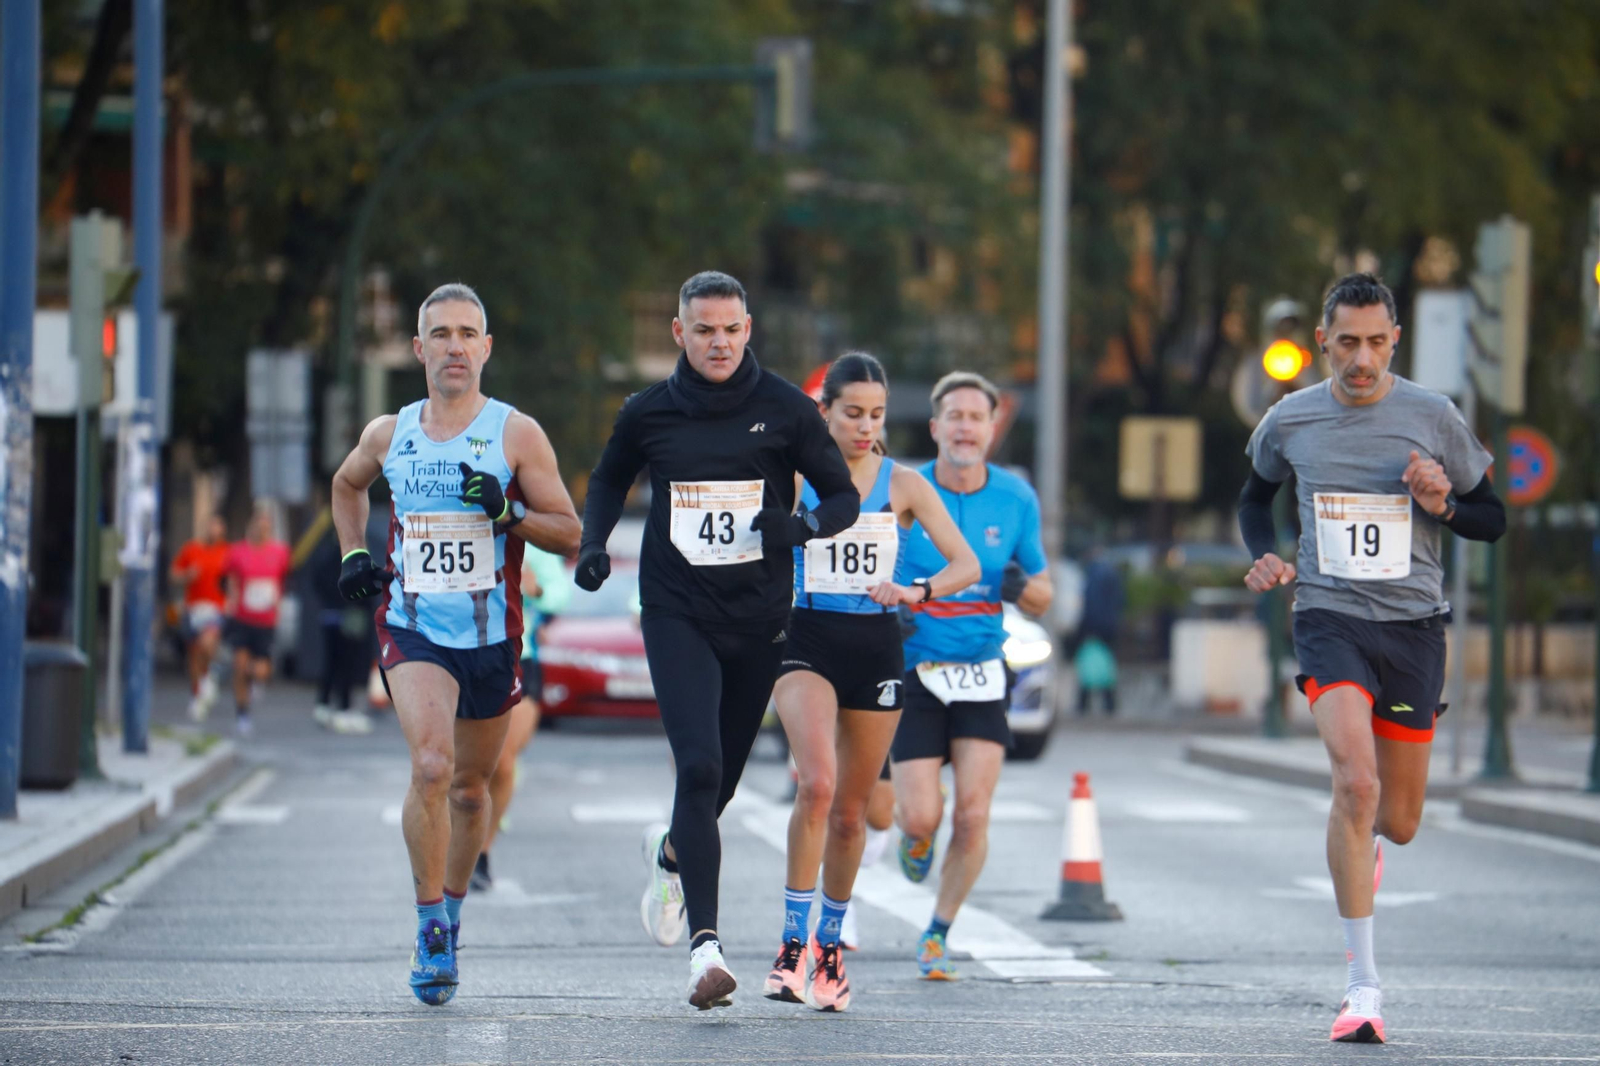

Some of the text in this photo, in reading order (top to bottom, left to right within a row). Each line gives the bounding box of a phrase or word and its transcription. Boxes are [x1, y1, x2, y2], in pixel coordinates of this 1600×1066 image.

[675, 484, 700, 508] XLI
[1319, 496, 1344, 520] XLI
[407, 515, 429, 538] XLI
[698, 511, 735, 546] 43
[1345, 523, 1380, 557] 19
[420, 541, 475, 574] 255
[825, 542, 878, 575] 185
[939, 663, 988, 691] 128
